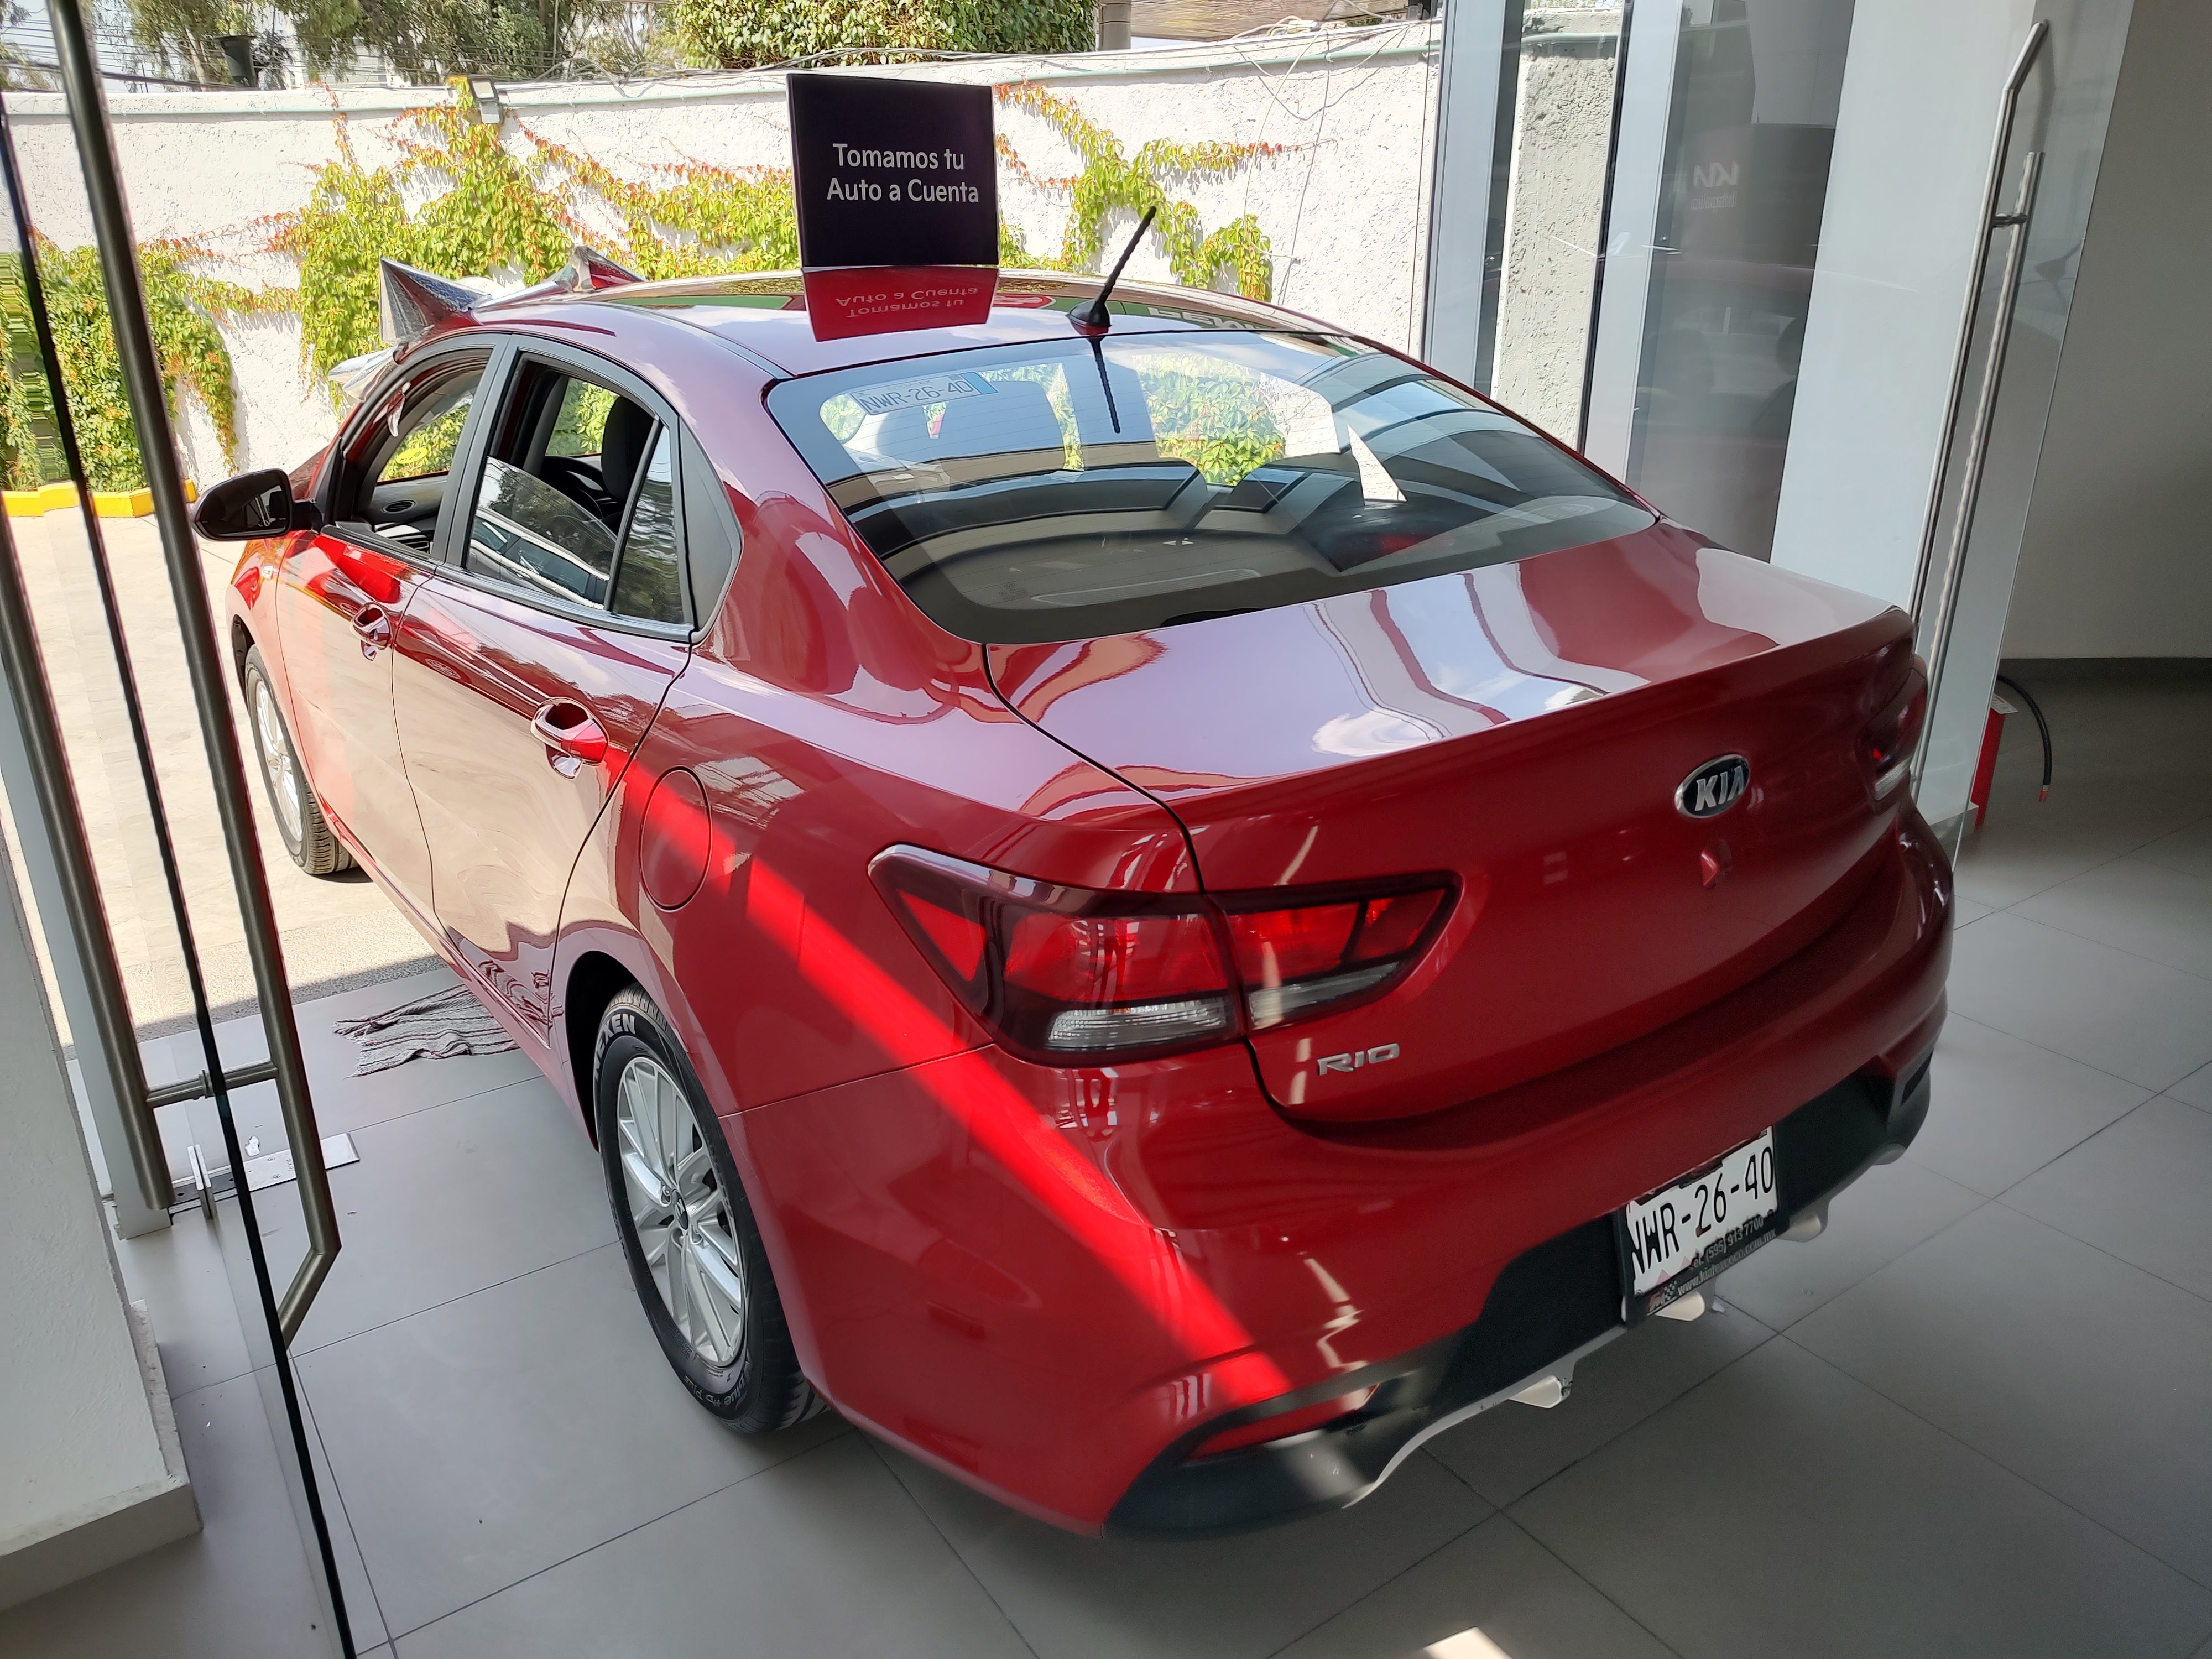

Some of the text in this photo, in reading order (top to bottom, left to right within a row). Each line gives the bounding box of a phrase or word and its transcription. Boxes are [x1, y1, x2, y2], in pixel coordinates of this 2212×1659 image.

[832, 143, 964, 170] Tomamos tu
[827, 178, 979, 203] Auto a Cuenta
[859, 380, 974, 410] NWR-26-40
[1694, 765, 1745, 812] KIA
[594, 1013, 636, 1082] NEXEN
[1317, 1042, 1400, 1076] RIO
[1630, 1146, 1774, 1274] NWR-26-40
[1744, 1217, 1765, 1237] 7700
